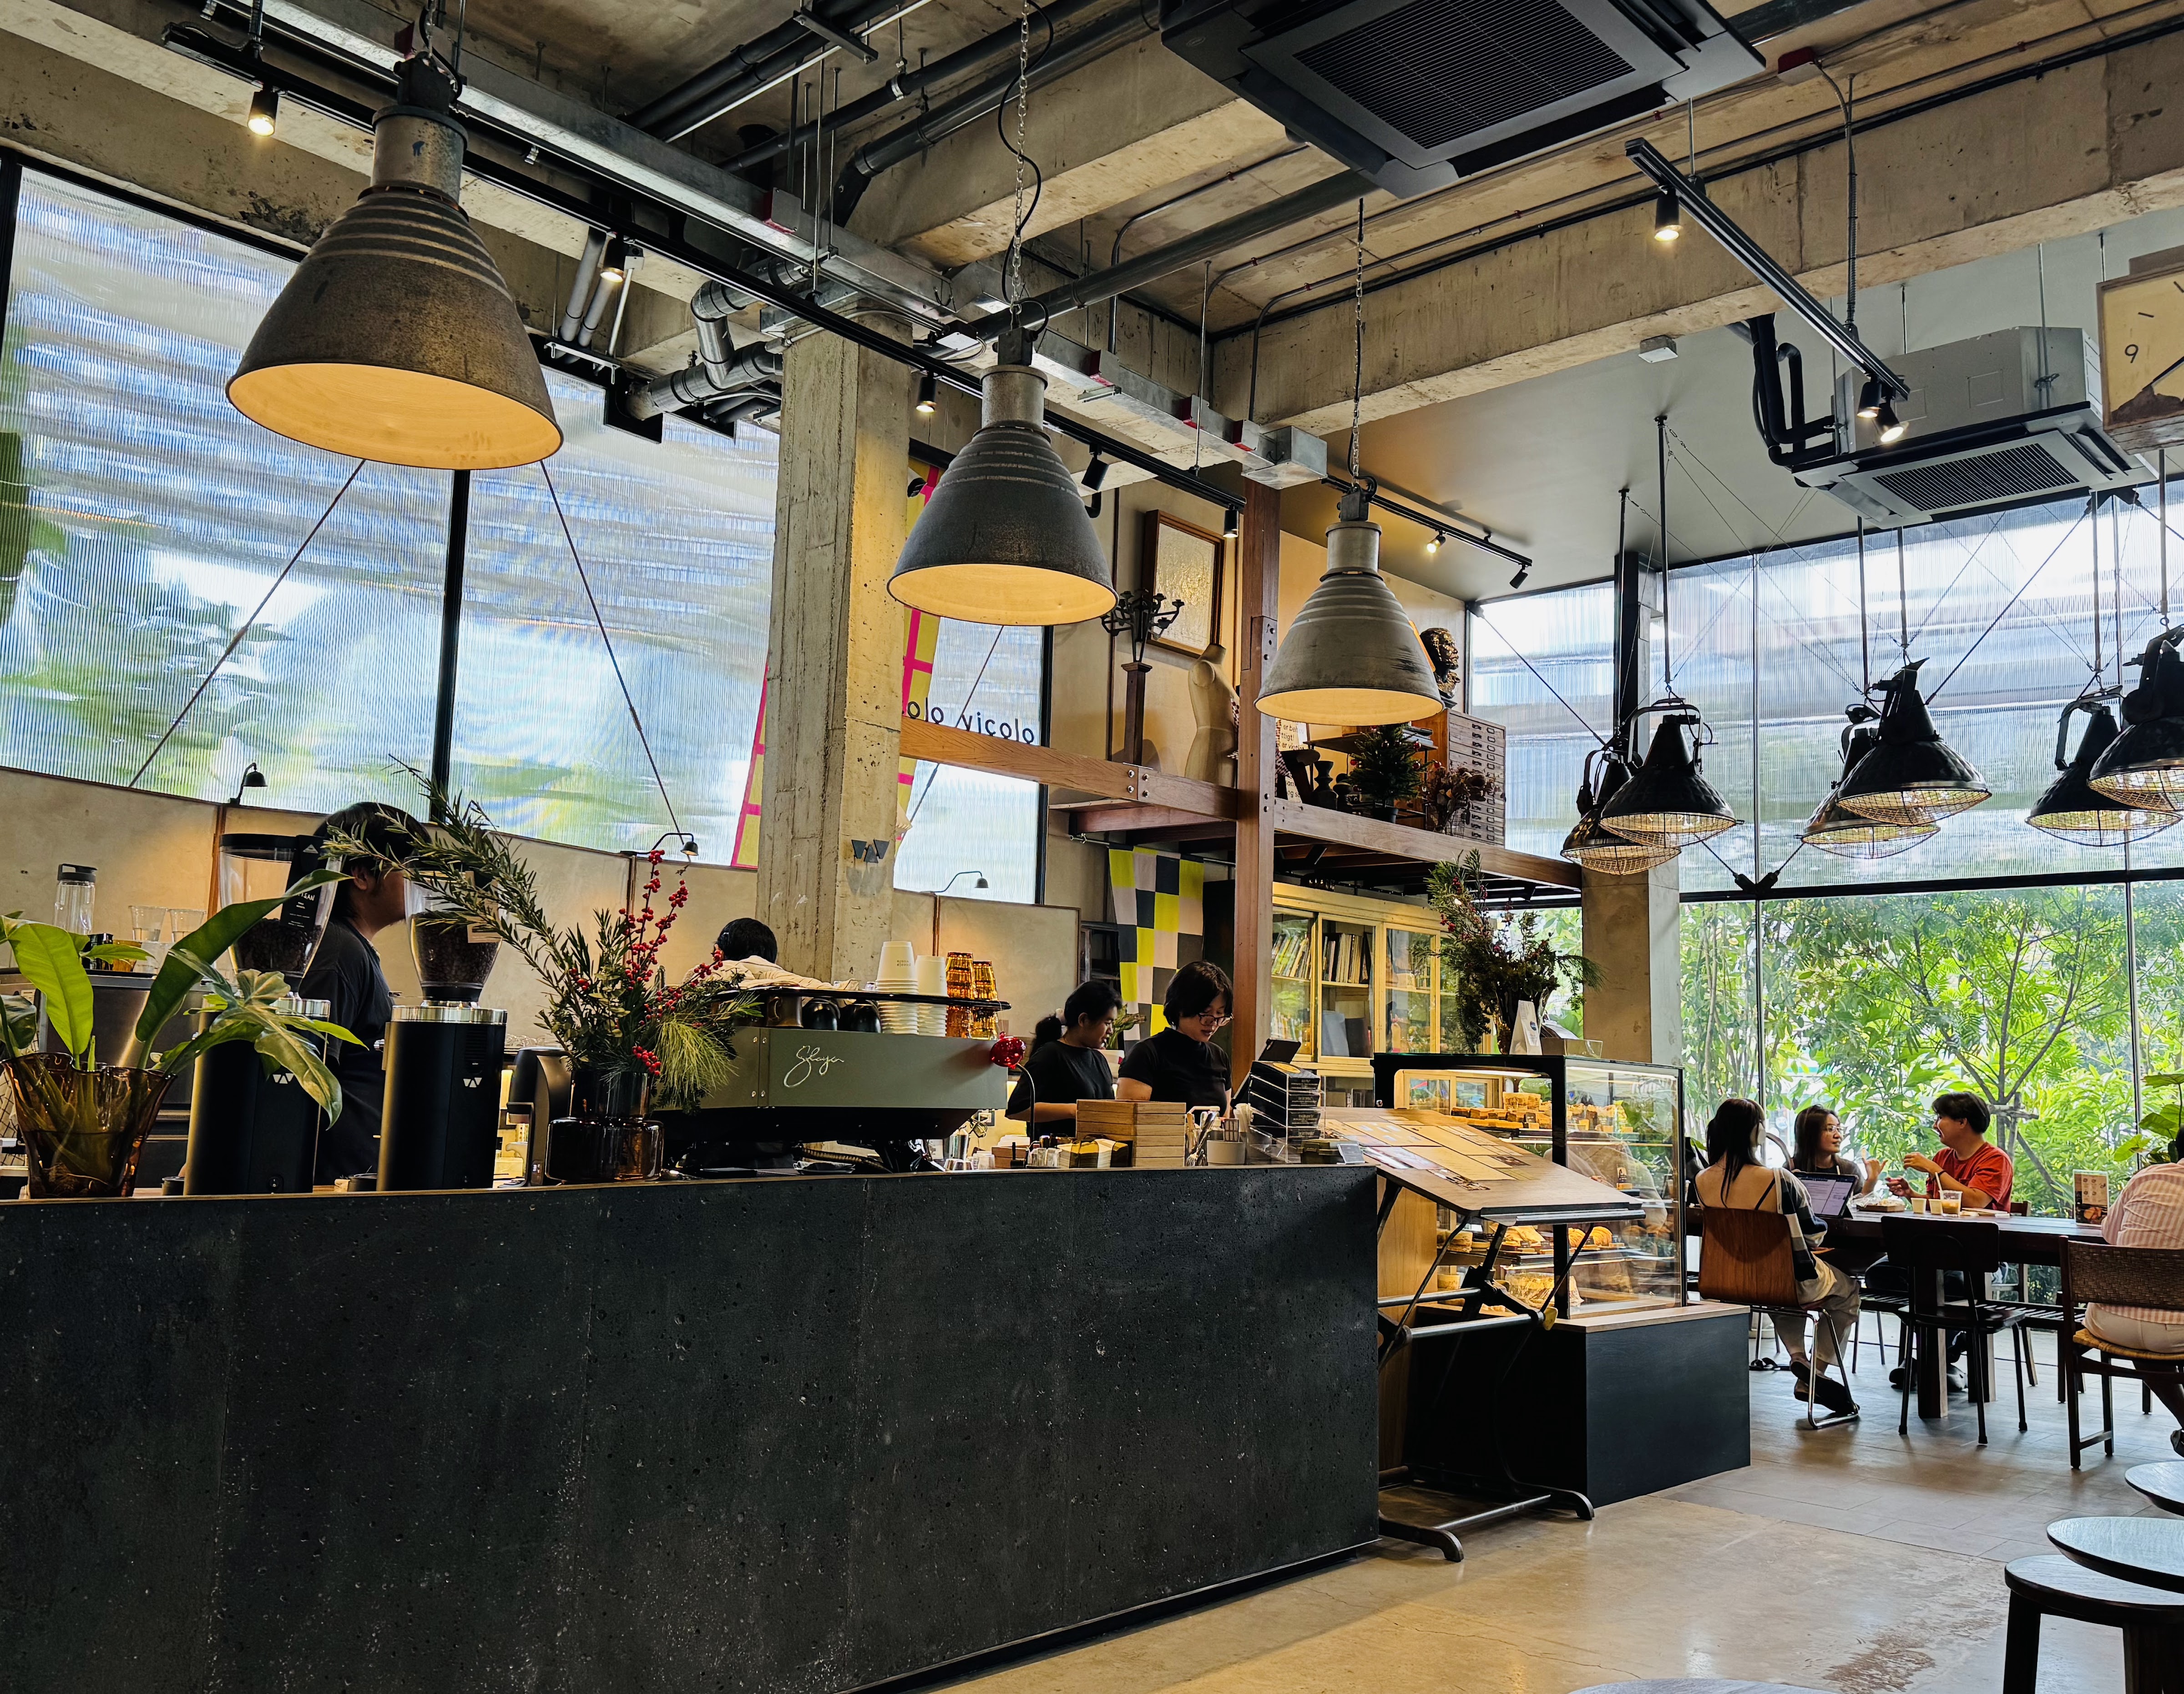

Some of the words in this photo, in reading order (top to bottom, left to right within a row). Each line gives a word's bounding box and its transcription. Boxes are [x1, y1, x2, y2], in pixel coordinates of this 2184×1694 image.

[2125, 344, 2138, 363] 9
[902, 697, 944, 724] olo
[961, 711, 1034, 744] vicolo
[298, 892, 315, 901] ISAN
